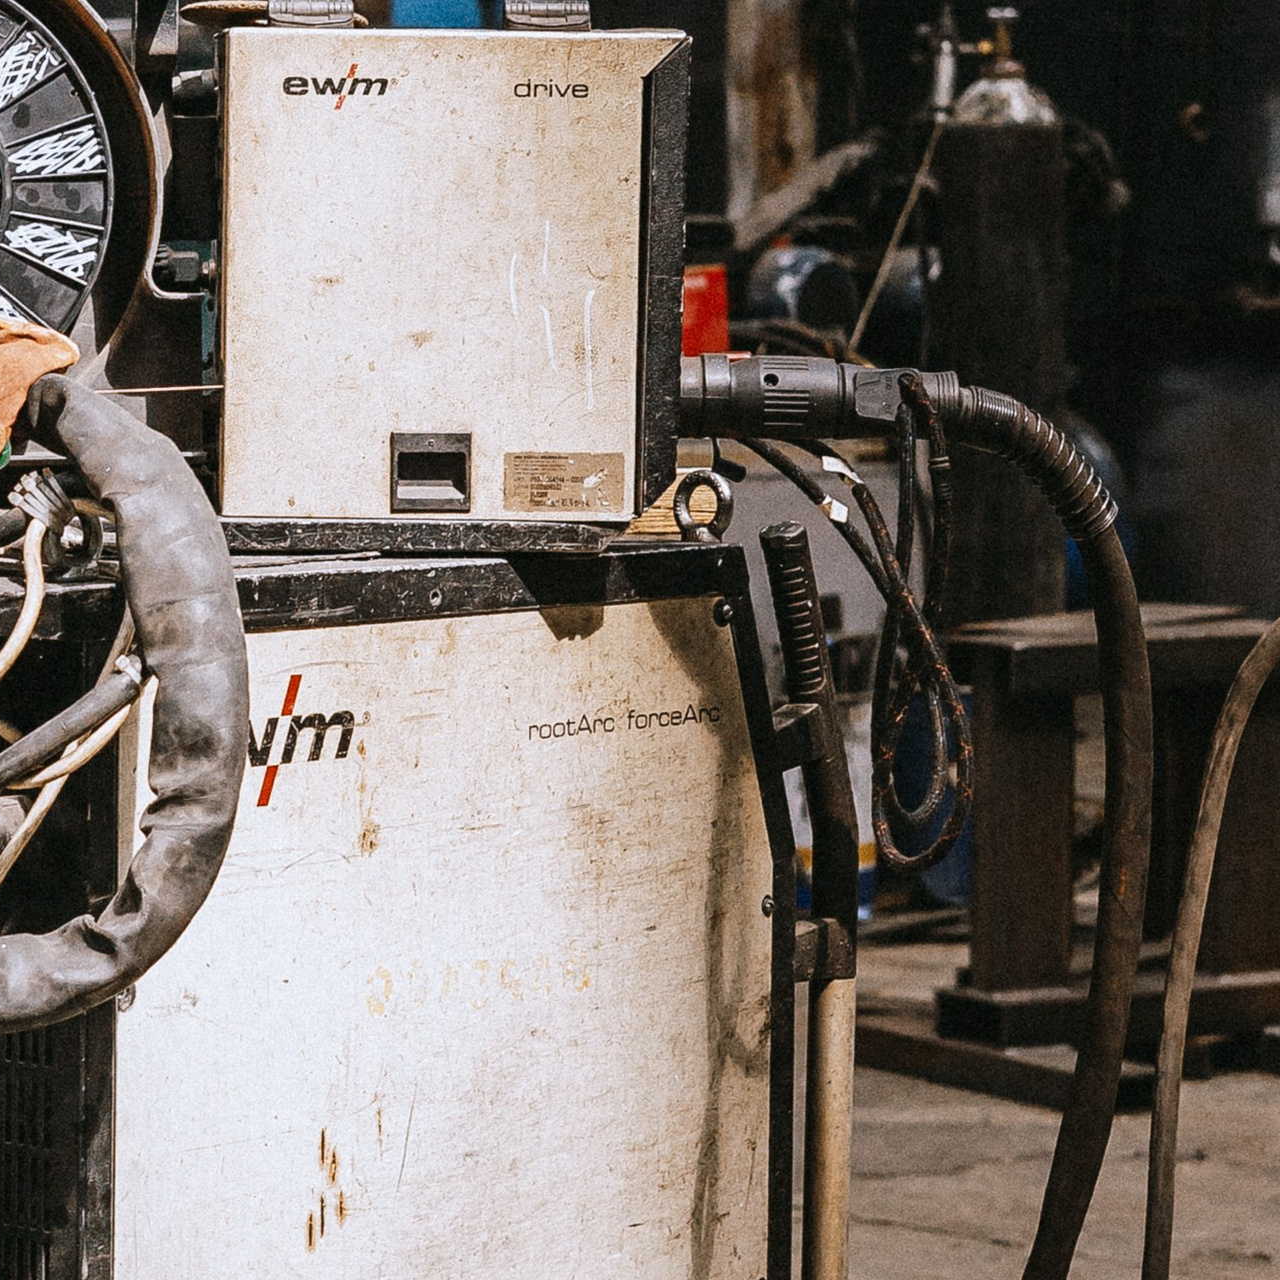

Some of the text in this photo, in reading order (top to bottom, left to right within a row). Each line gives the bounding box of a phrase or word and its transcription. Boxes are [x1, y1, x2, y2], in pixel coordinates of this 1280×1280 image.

[513, 78, 589, 99] drive
[528, 704, 720, 740] rootArc forceArc
